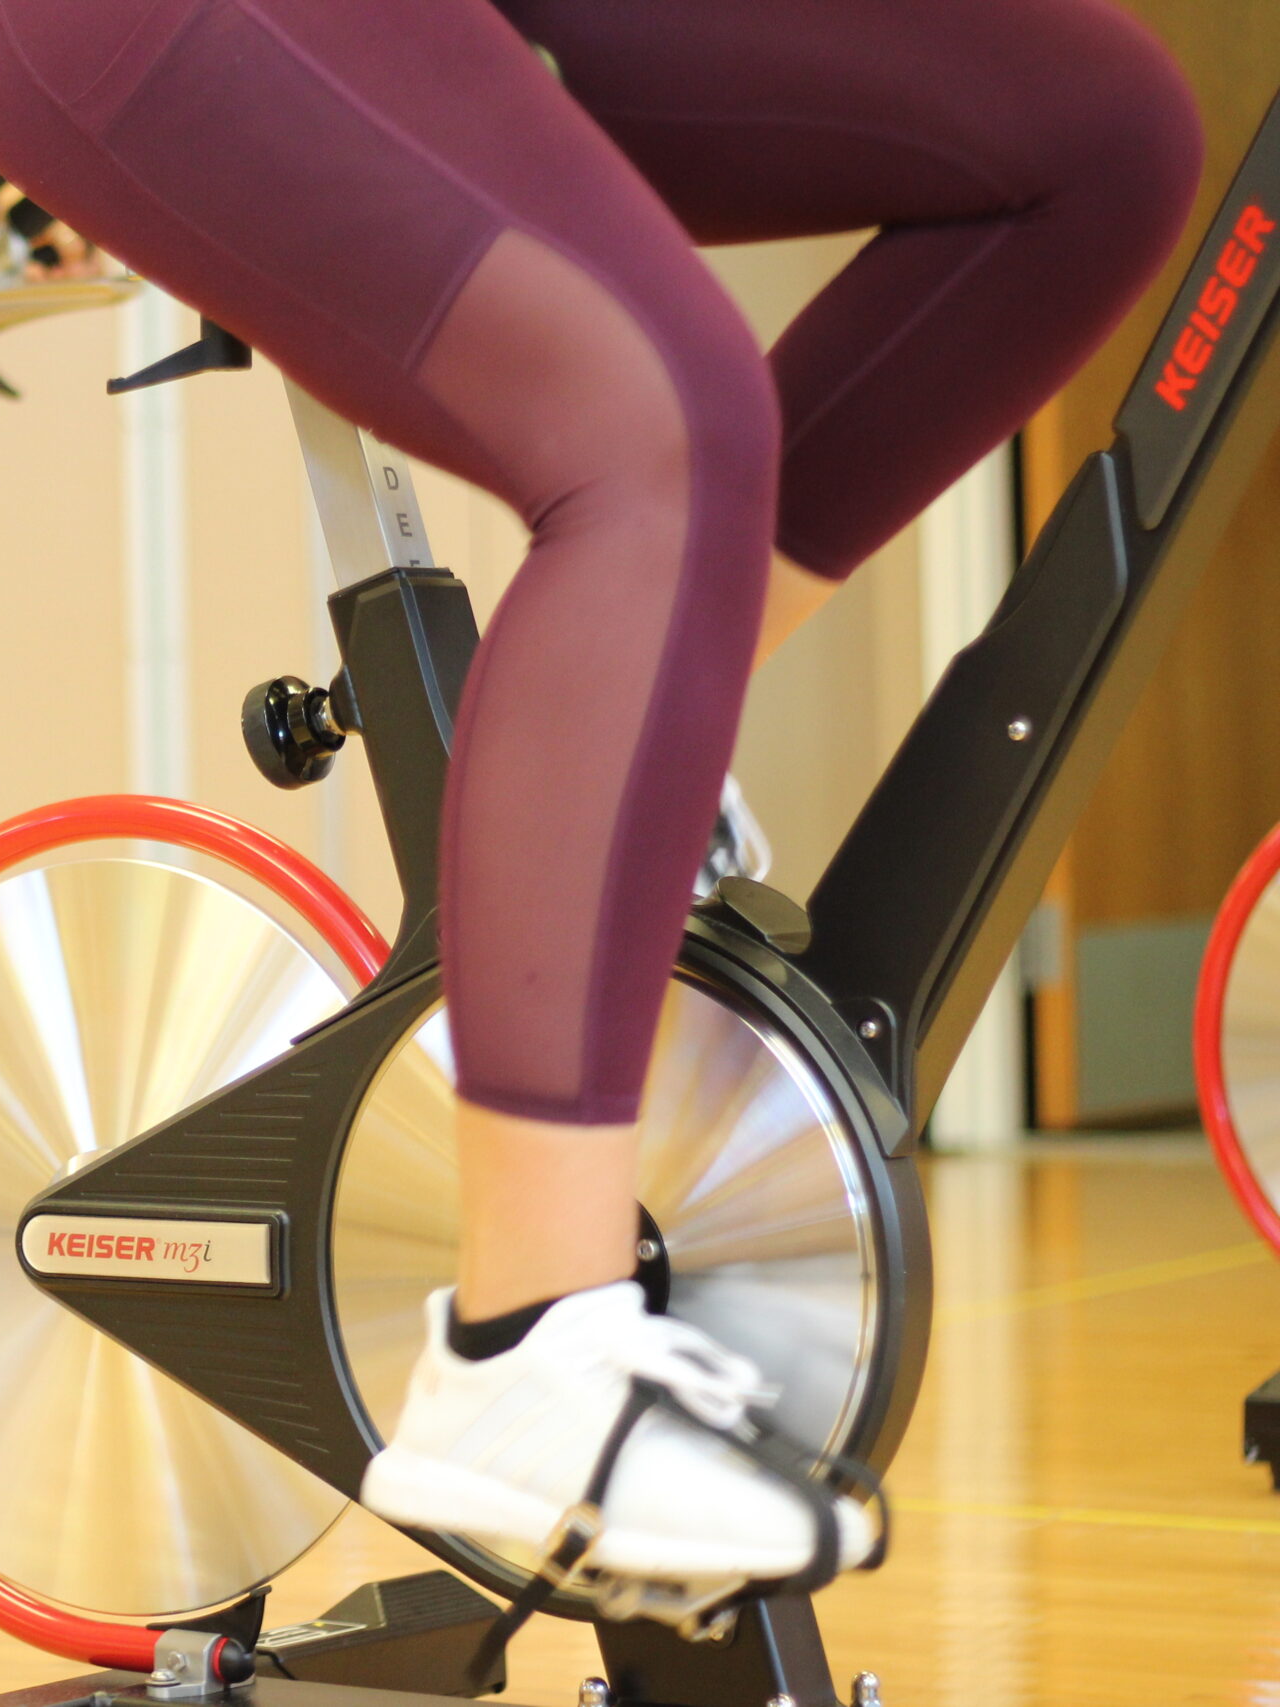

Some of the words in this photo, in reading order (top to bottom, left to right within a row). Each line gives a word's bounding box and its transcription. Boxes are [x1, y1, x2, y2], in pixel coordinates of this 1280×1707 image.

[1154, 204, 1276, 412] KEISER
[383, 466, 399, 490] D
[396, 513, 412, 537] E
[47, 1232, 155, 1261] KEISER
